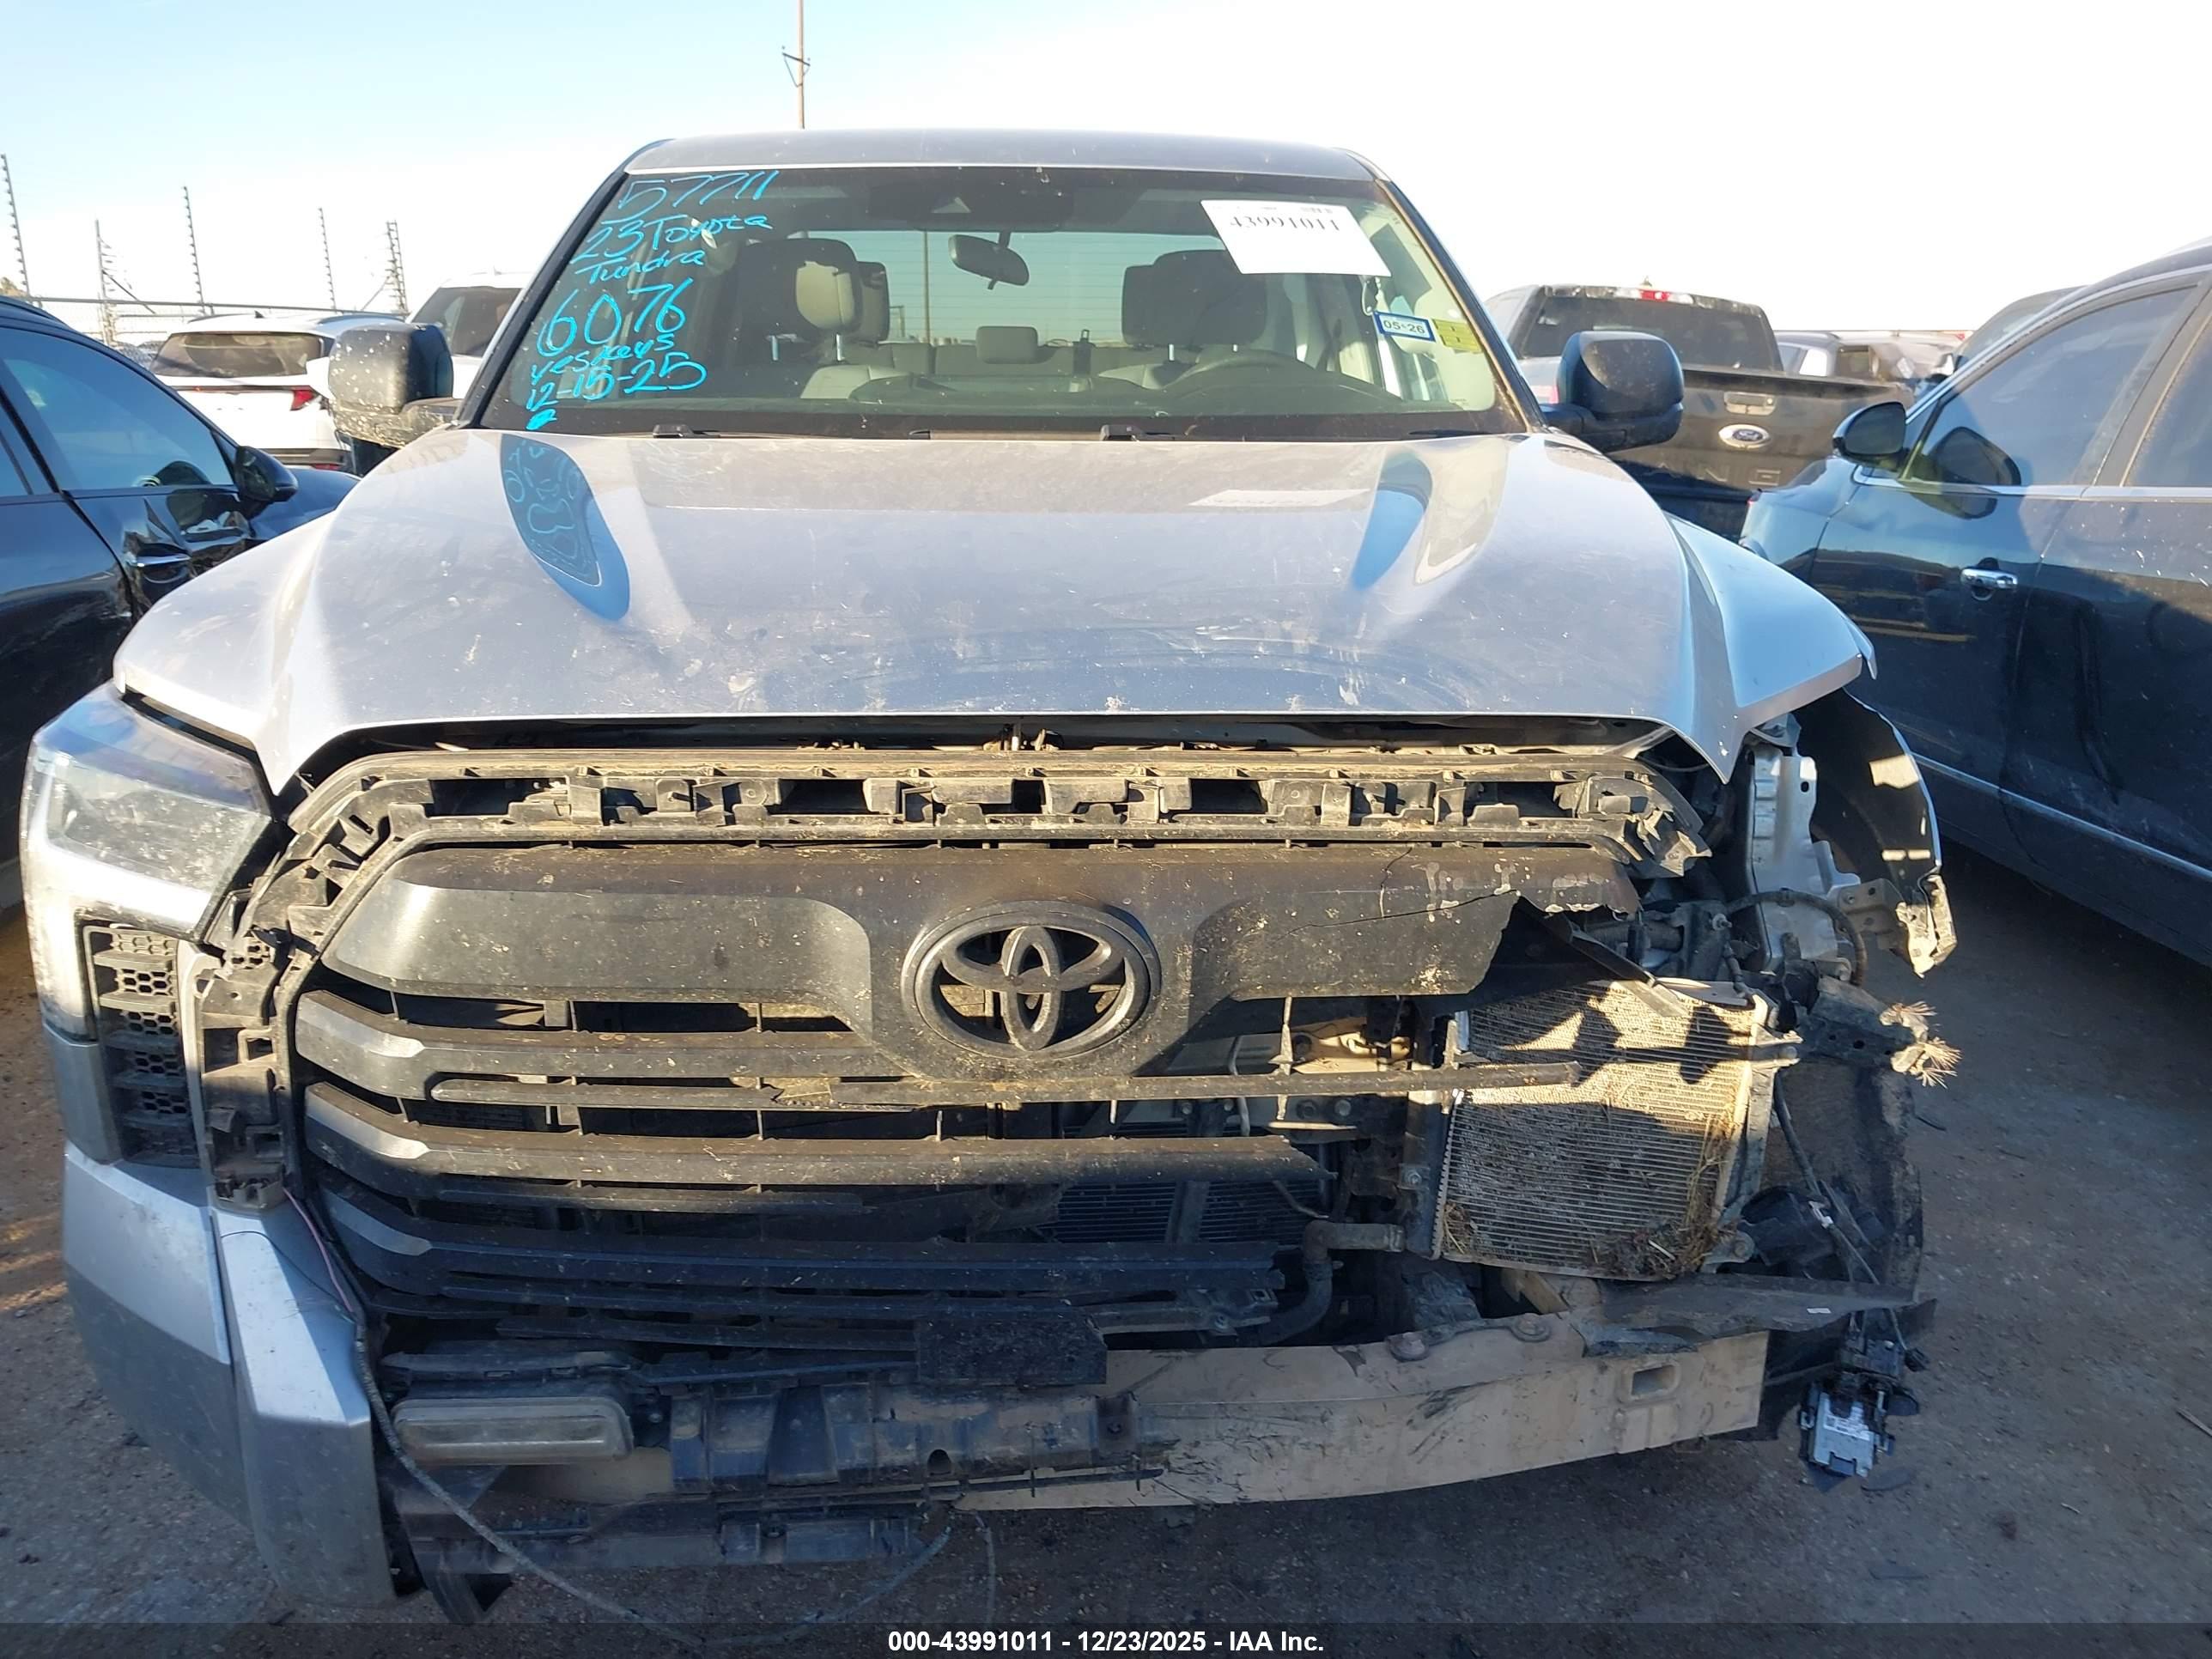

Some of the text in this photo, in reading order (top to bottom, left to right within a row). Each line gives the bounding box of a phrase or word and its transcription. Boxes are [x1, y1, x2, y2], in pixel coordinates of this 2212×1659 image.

[1230, 216, 1340, 231] 43991011
[574, 250, 705, 284] Tundra
[536, 277, 694, 357] 6076
